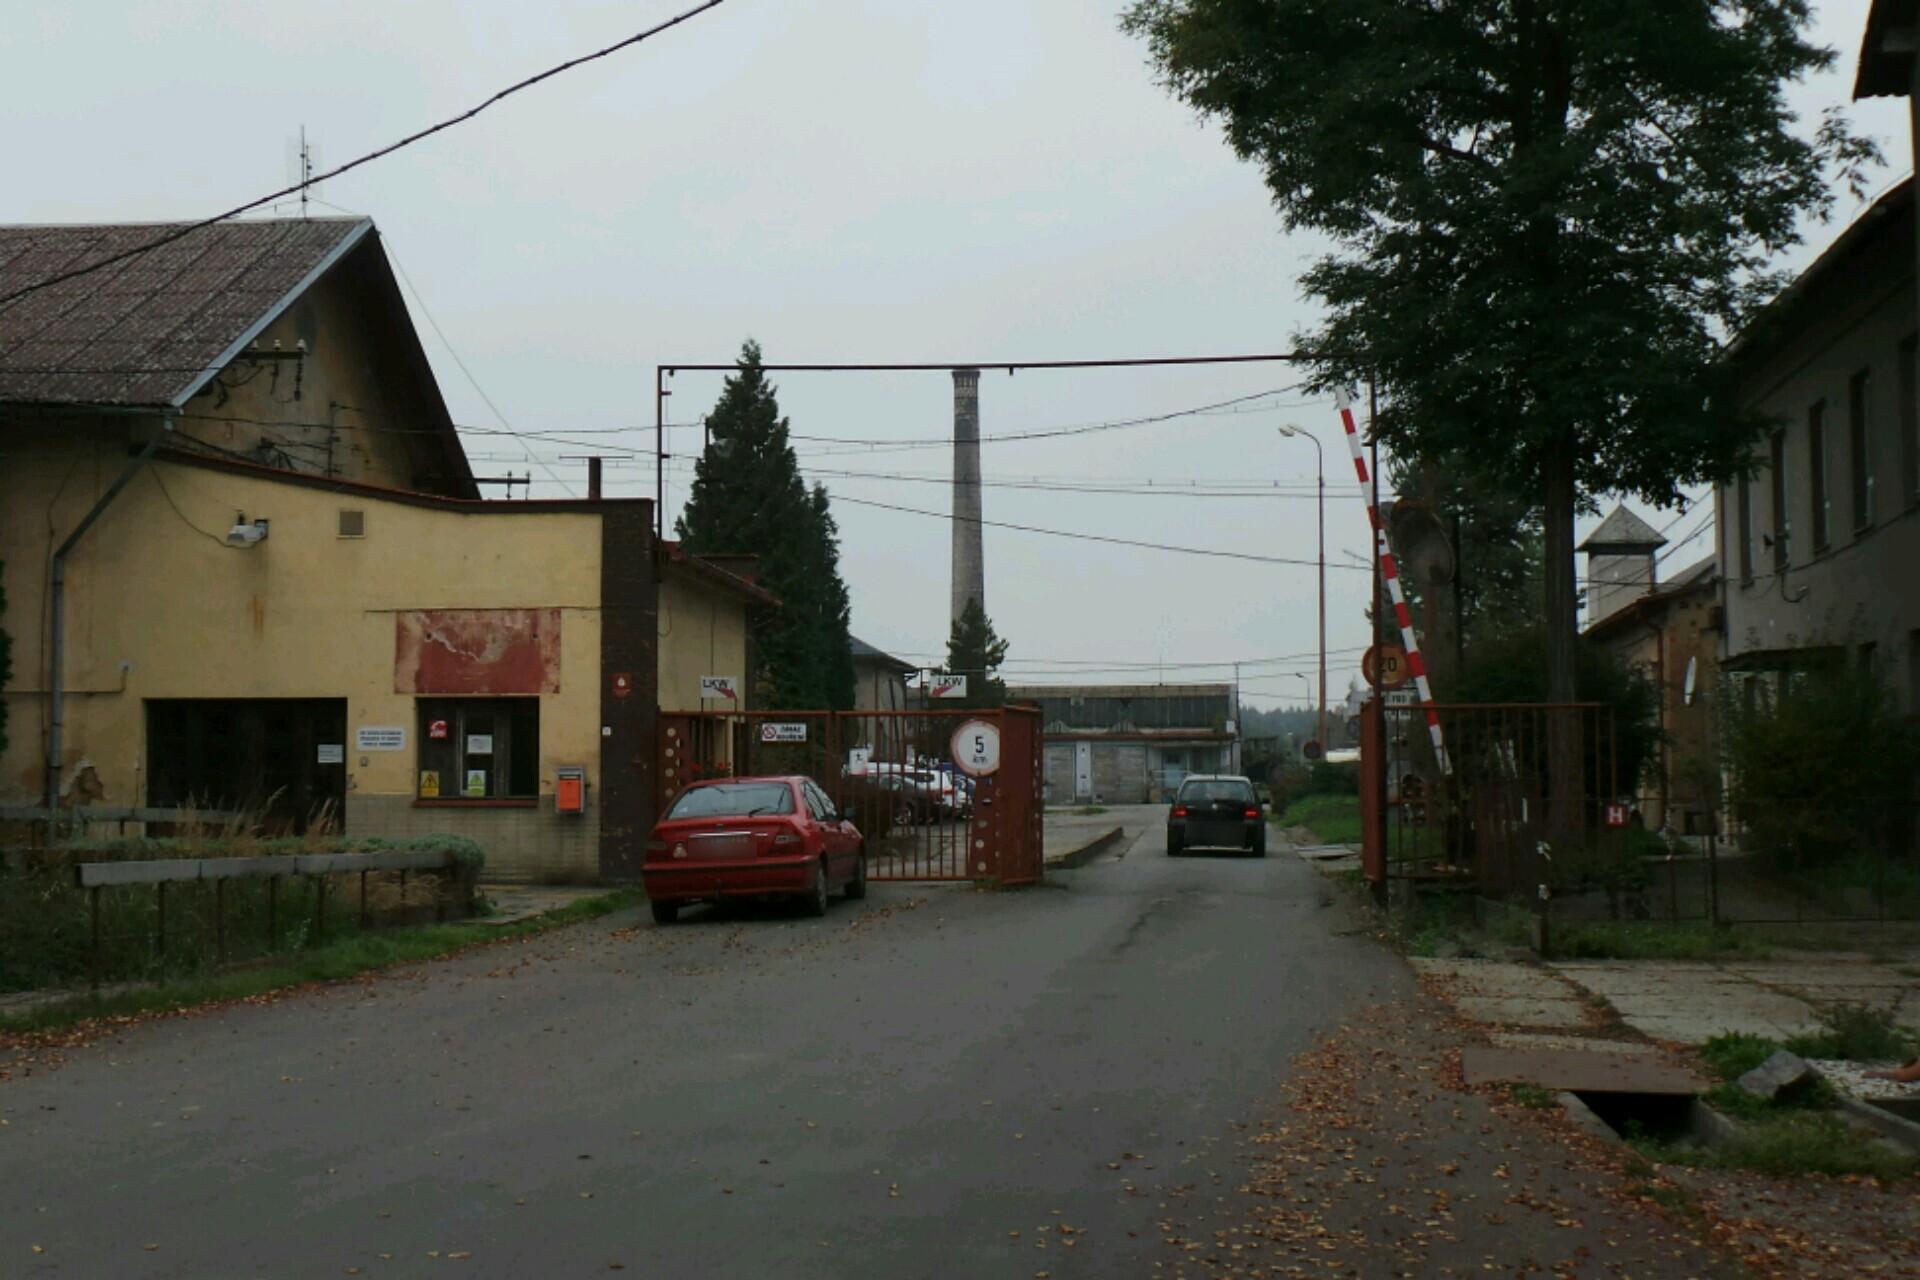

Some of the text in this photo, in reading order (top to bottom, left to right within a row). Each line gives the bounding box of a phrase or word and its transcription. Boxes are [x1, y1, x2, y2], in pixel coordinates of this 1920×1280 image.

[703, 679, 729, 689] LKW
[938, 677, 963, 687] LKW
[975, 736, 984, 753] 5
[1609, 806, 1622, 823] H
